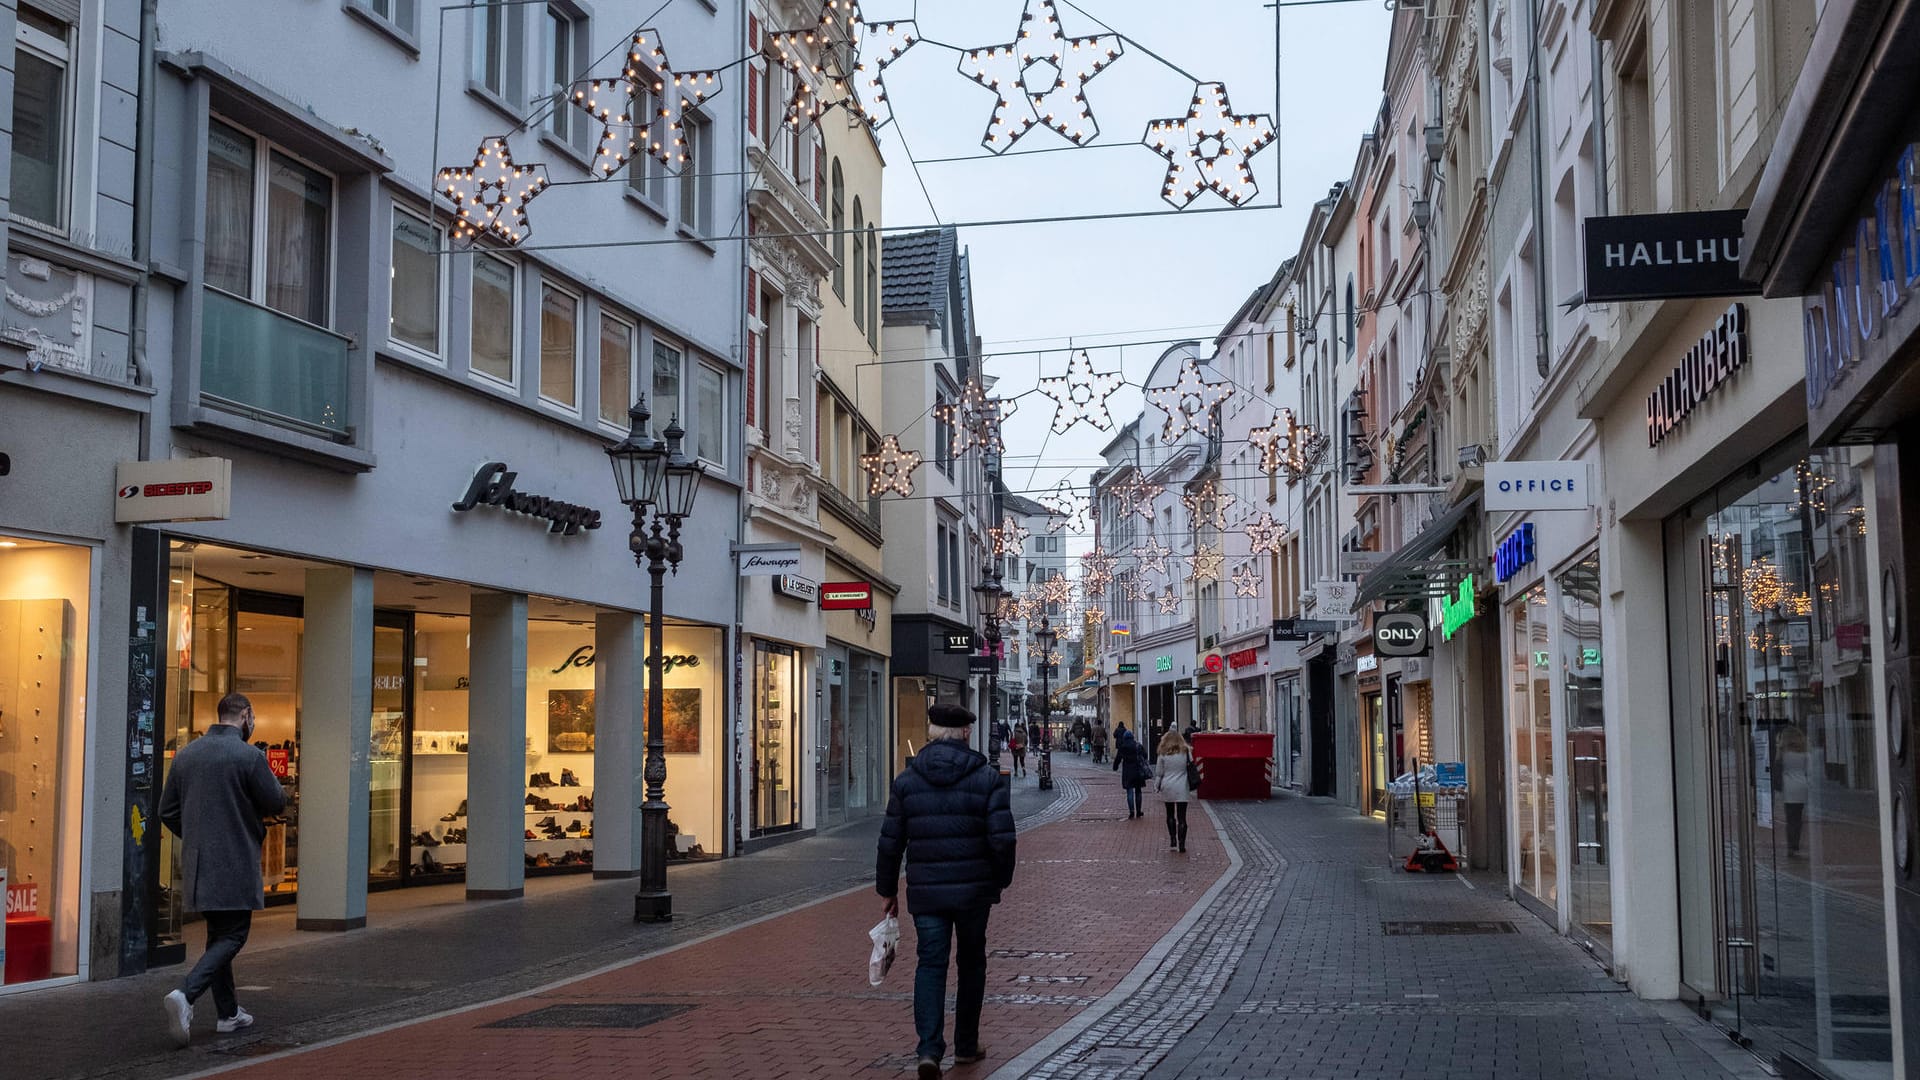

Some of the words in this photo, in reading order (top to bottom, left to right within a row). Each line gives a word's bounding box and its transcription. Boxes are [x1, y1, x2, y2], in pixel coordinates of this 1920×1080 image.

[1646, 302, 1748, 448] HALLHUBER
[143, 481, 213, 497] SIDESTEP
[1499, 479, 1574, 492] OFFICE
[1496, 523, 1535, 583] OFFICE
[1379, 628, 1423, 640] ONLY
[7, 888, 38, 914] SALE
